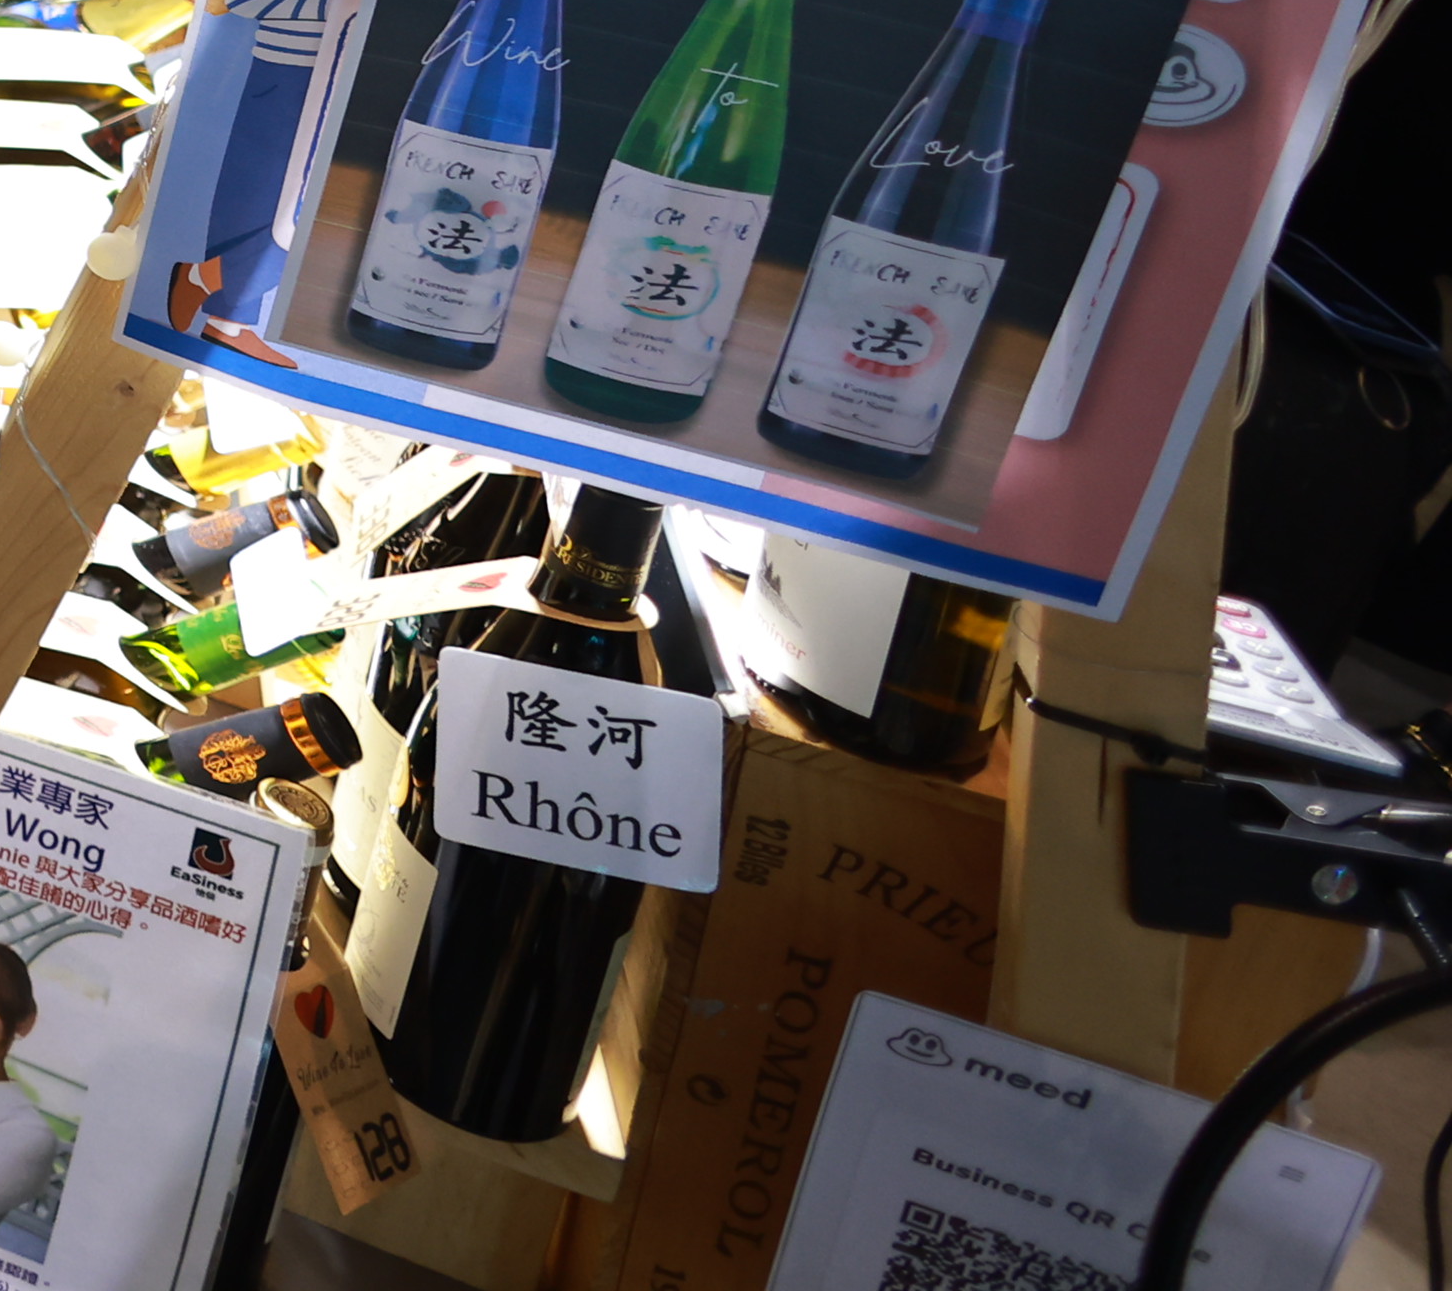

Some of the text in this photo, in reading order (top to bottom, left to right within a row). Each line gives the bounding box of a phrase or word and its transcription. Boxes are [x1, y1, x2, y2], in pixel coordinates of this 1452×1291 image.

[421, 0, 572, 71] Wine
[870, 97, 1015, 174] Love
[428, 220, 483, 254] 法
[627, 263, 700, 307] 法
[852, 319, 924, 361] 法
[505, 691, 658, 770] 隆河
[5, 806, 106, 873] Wong
[471, 769, 682, 858] Rhône
[169, 865, 244, 902] EaSiness
[715, 946, 834, 1258] POMEROL
[964, 1056, 1093, 1110] meed
[353, 1112, 411, 1182] 128
[912, 1146, 1055, 1209] Business
[1065, 1200, 1116, 1230] QR
